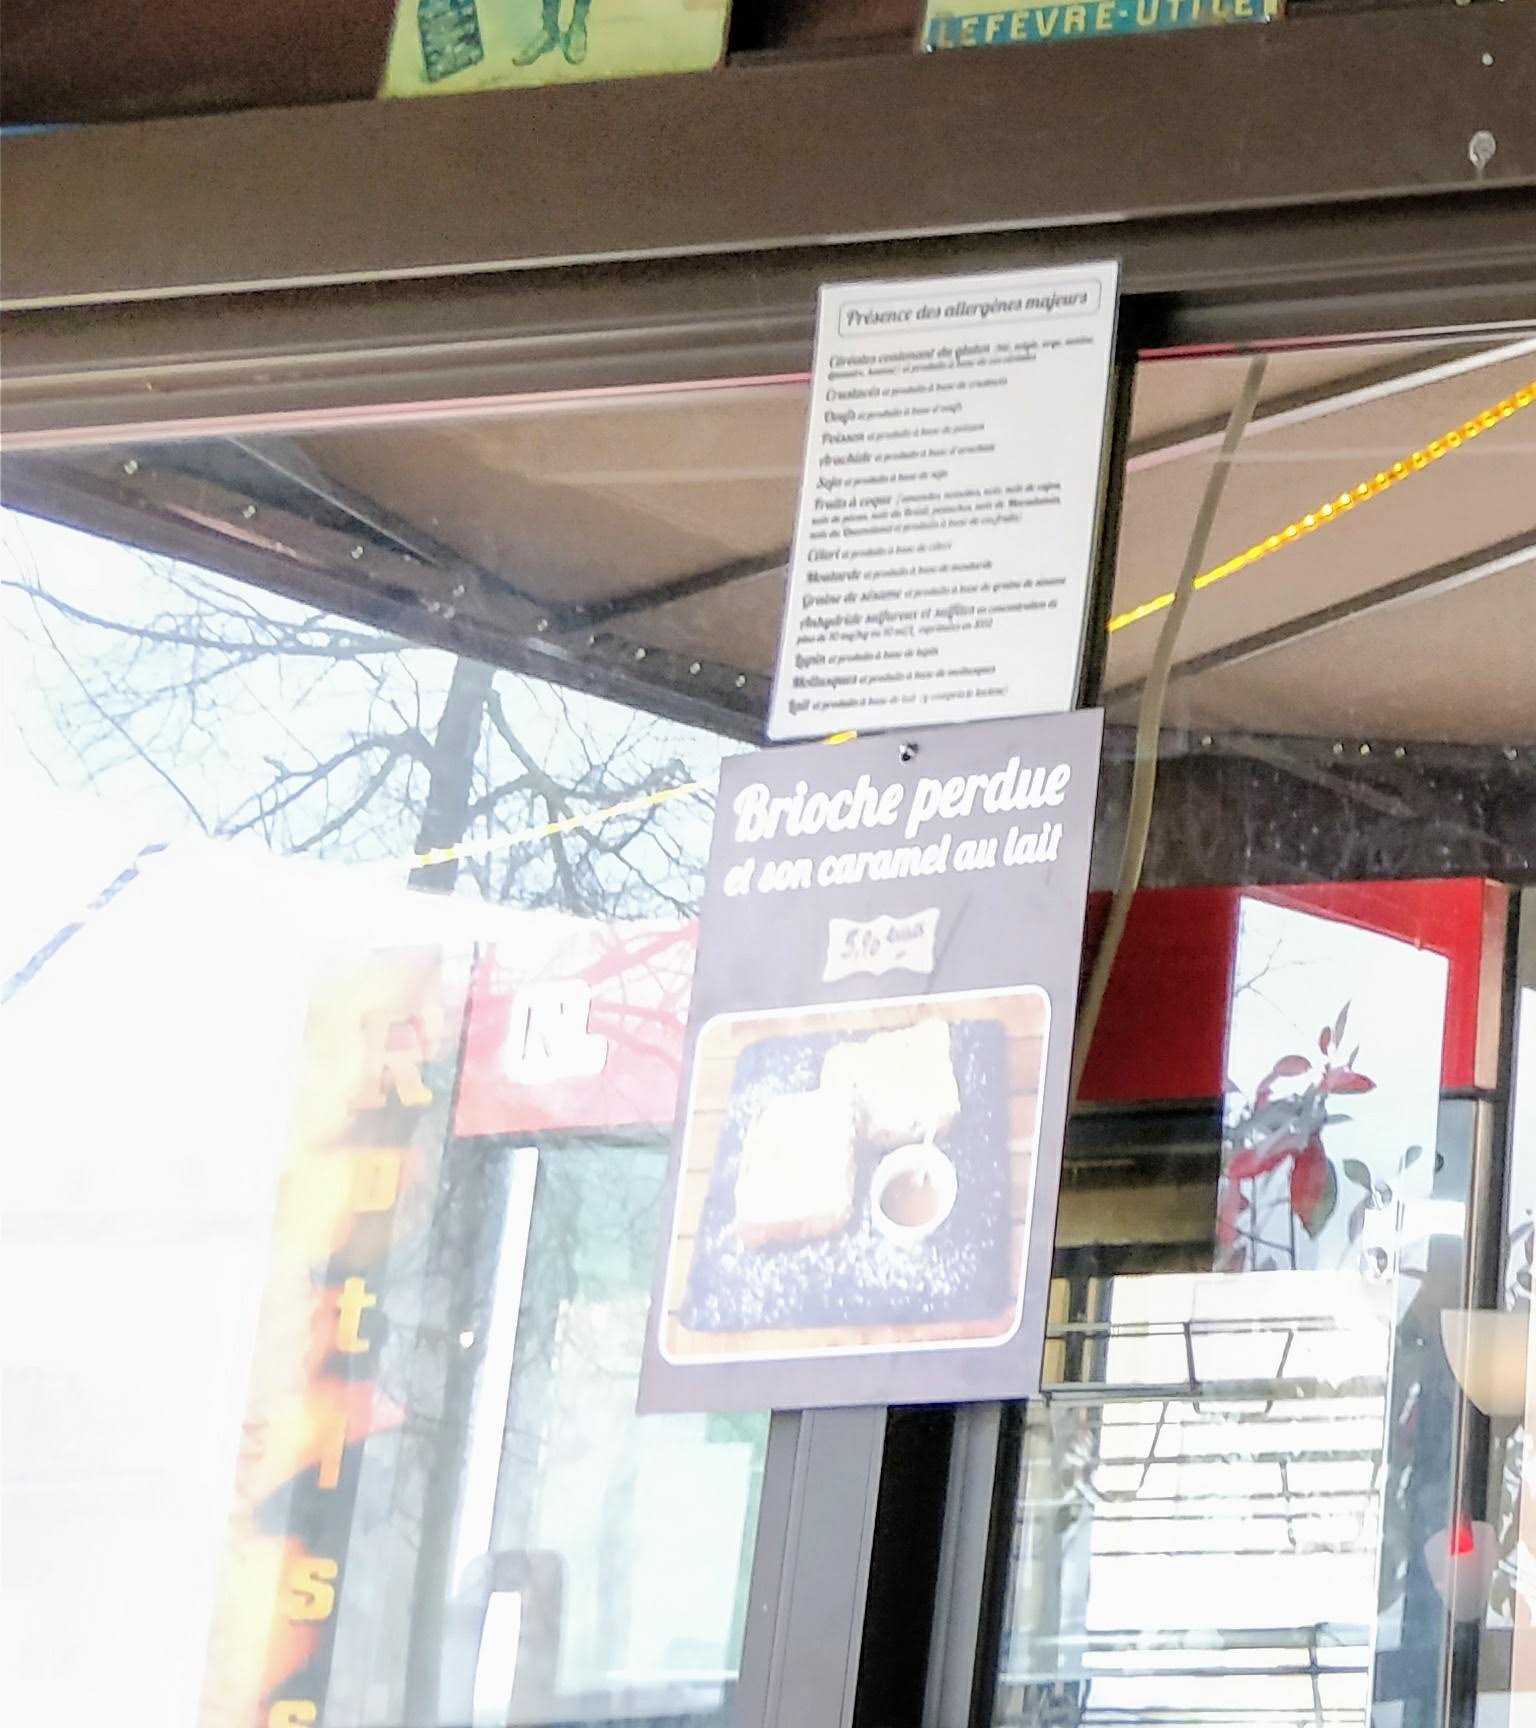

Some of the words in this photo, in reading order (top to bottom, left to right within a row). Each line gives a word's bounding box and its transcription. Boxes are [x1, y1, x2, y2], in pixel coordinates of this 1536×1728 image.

[845, 303, 913, 327] Présence
[915, 301, 942, 321] des
[943, 294, 1023, 322] allergènes
[1024, 289, 1088, 314] majeurs
[732, 774, 898, 844] Brioche
[905, 756, 1072, 841] perdue
[722, 856, 757, 899] et
[757, 857, 812, 891] son
[815, 839, 950, 889] caramel
[952, 834, 997, 873] au
[1003, 821, 1065, 869] lait
